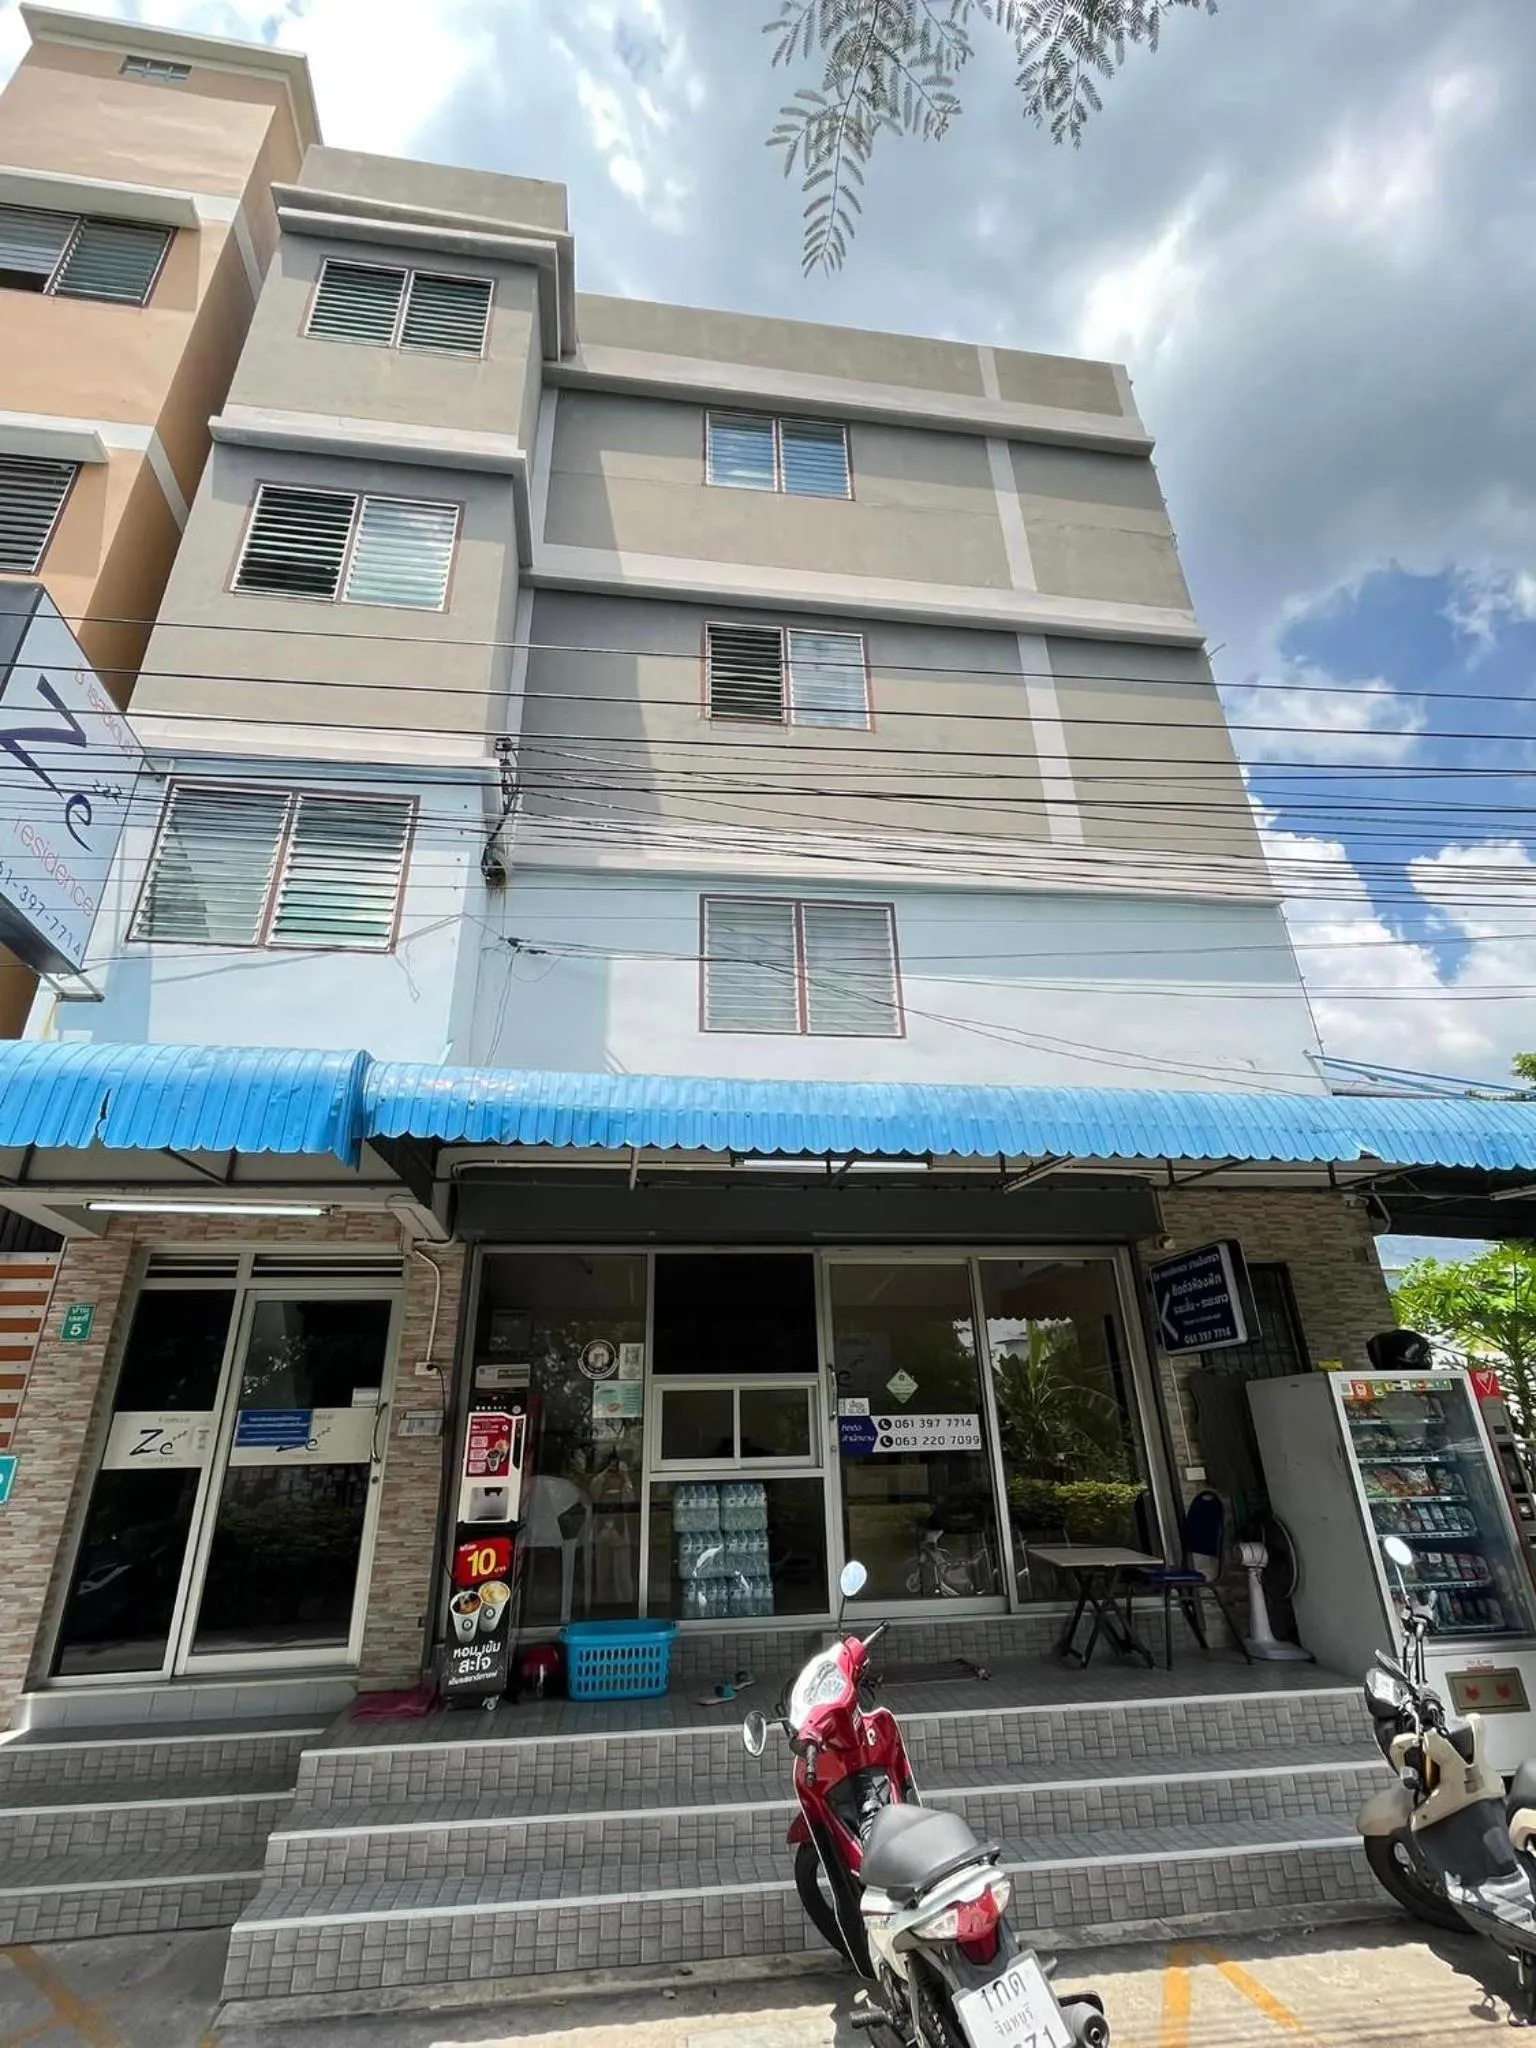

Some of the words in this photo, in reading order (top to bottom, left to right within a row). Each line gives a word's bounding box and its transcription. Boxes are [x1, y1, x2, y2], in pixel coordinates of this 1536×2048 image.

[12, 815, 94, 917] residence
[70, 1323, 82, 1336] 5
[894, 1418, 914, 1429] 061
[919, 1418, 941, 1428] 397
[946, 1418, 972, 1428] 7714
[895, 1436, 918, 1446] 063
[922, 1436, 946, 1446] 220
[950, 1435, 980, 1445] 7099
[467, 1547, 497, 1577] 10
[453, 1644, 479, 1659] หอม
[458, 1651, 491, 1673] สะใจ
